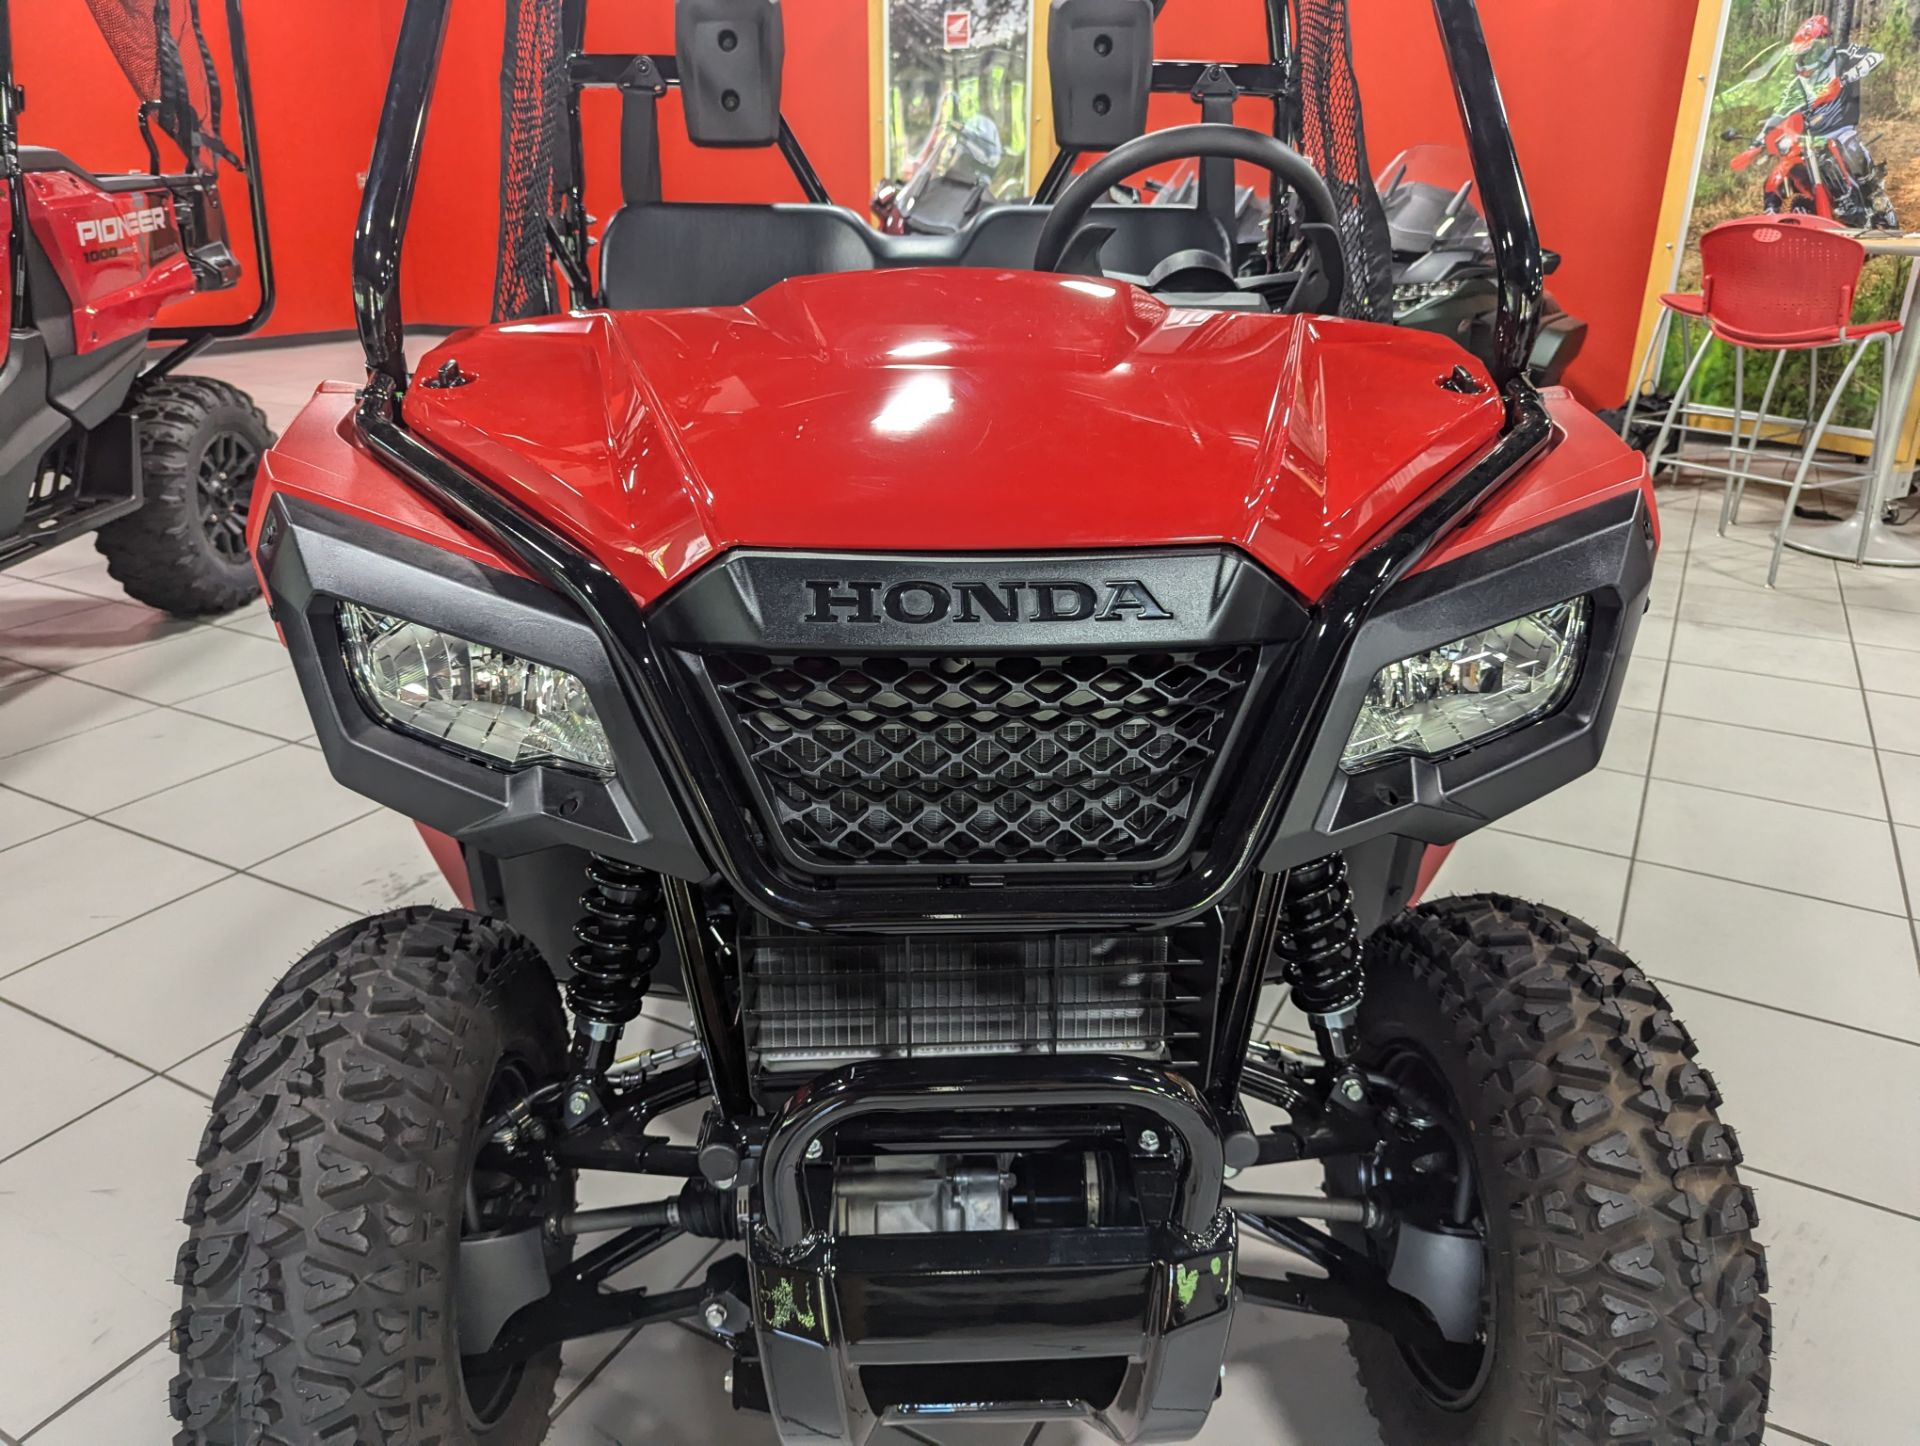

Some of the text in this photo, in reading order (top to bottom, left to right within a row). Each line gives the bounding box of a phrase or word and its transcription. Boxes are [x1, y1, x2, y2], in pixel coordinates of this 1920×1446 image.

[76, 206, 166, 247] PIONEER
[83, 247, 117, 263] 1000
[804, 580, 1174, 624] HONDA
